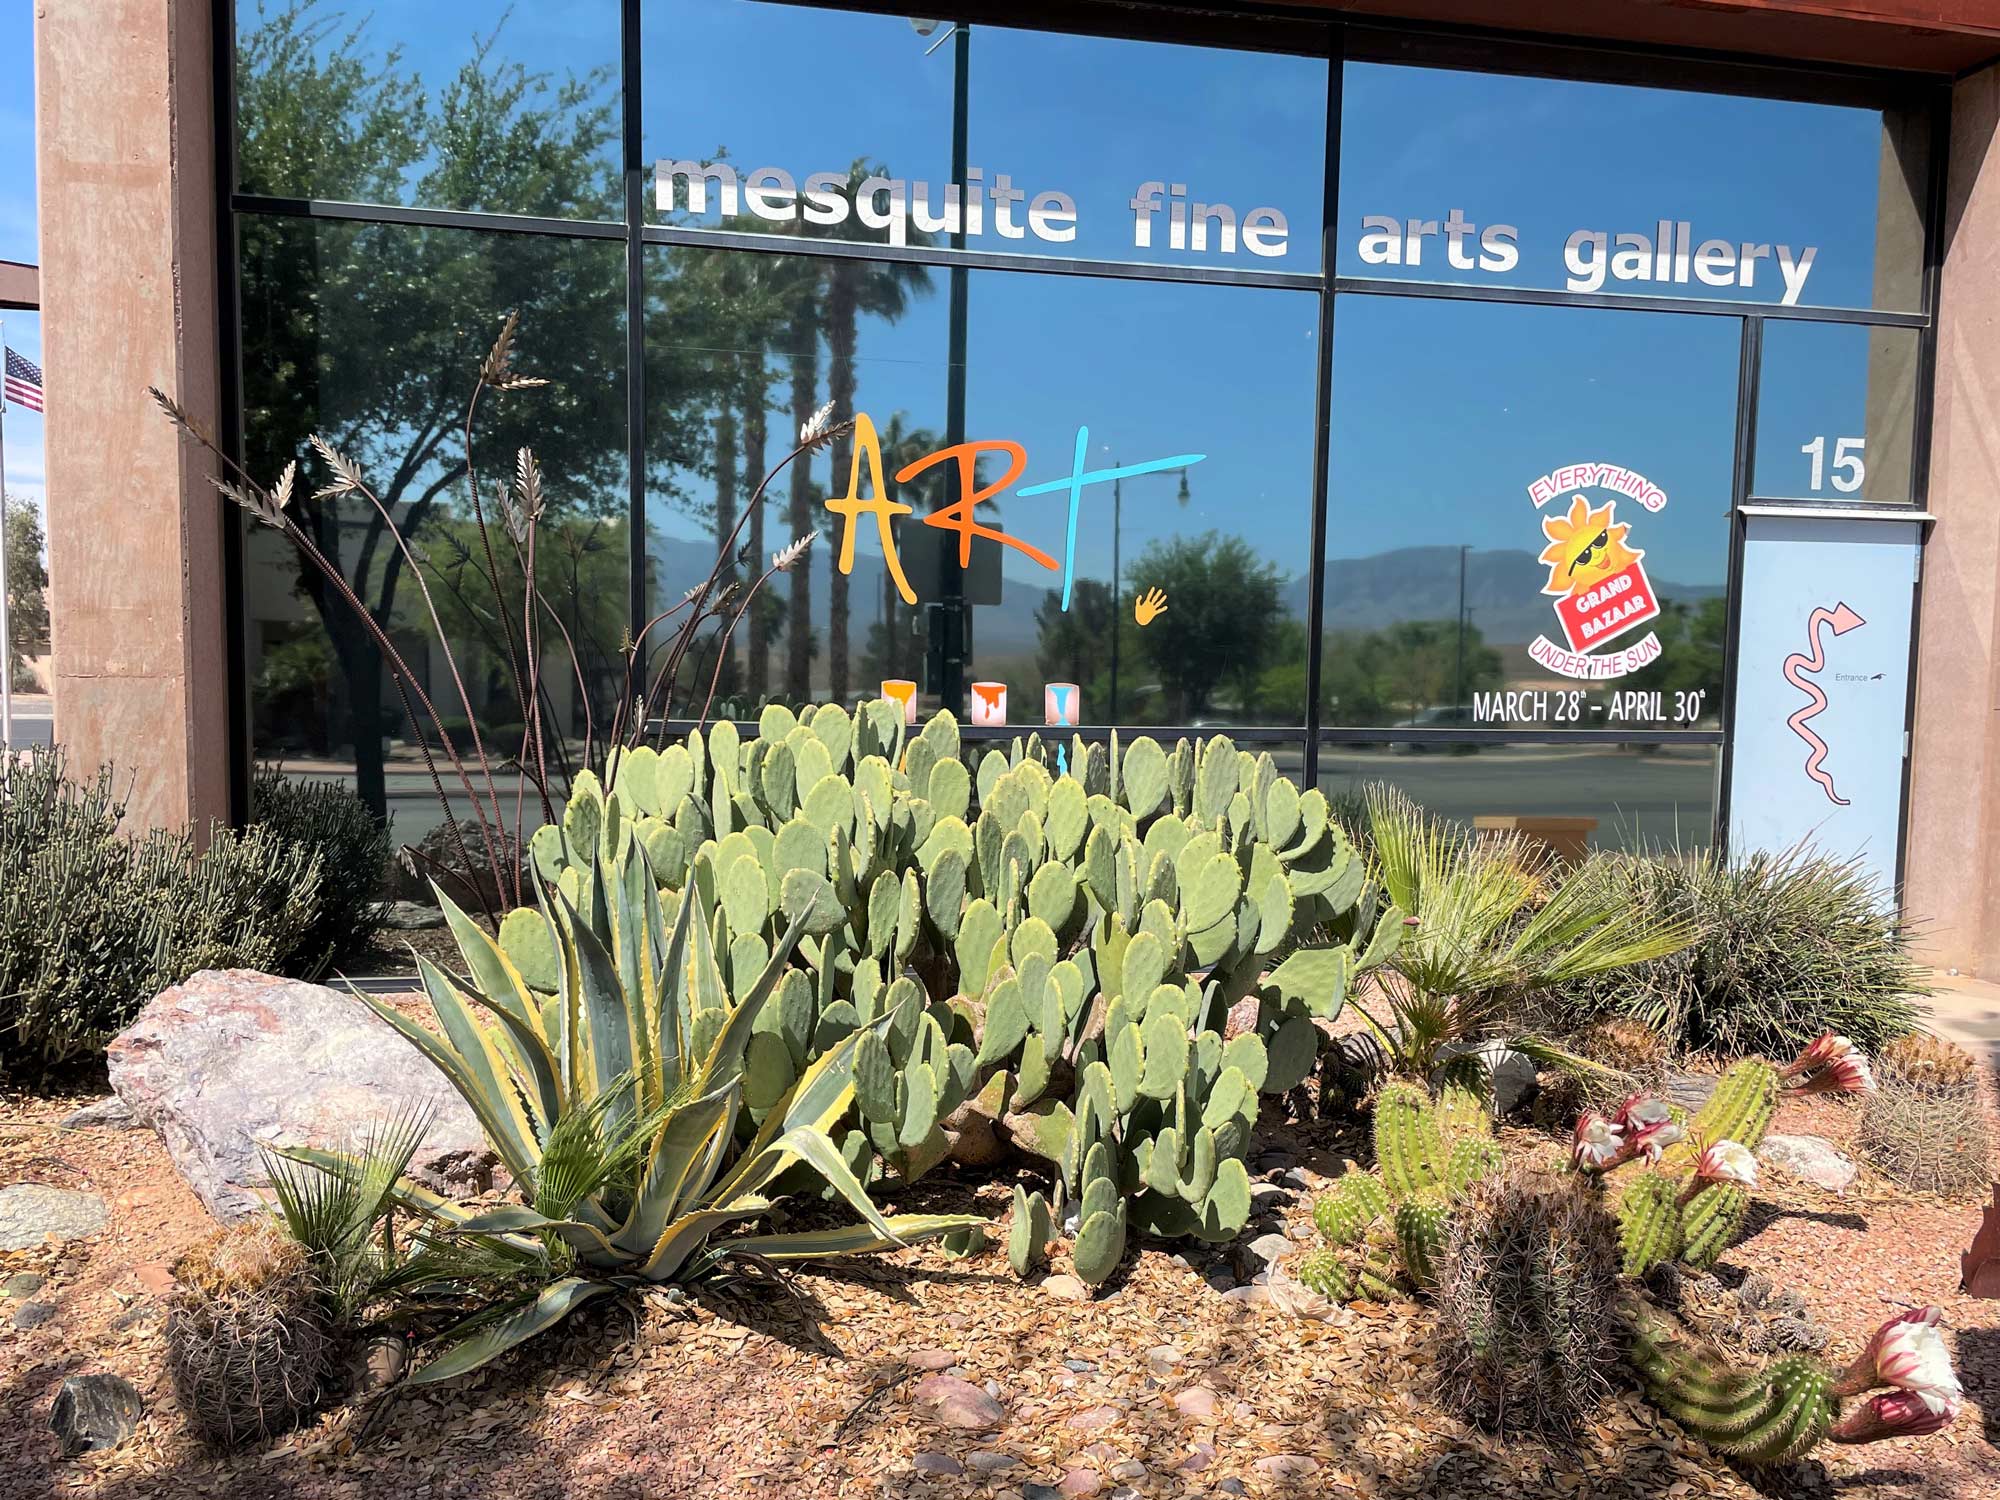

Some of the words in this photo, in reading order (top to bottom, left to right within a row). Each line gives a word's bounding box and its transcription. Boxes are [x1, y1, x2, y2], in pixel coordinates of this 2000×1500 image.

[656, 159, 1076, 246] mesquite
[1130, 182, 1288, 257] fine
[1358, 209, 1519, 272] arts
[1564, 220, 1818, 305] gallery
[1801, 436, 1866, 492] 15
[1530, 466, 1664, 510] EVERYTHING
[1575, 574, 1633, 614] GRAND
[1580, 595, 1647, 639] BAZAAR
[1531, 639, 1587, 676] UNDER
[1592, 658, 1623, 676] THE
[1626, 637, 1659, 669] SUN
[1835, 673, 1868, 682] Entrance
[1473, 691, 1547, 722] MARCH
[1608, 691, 1667, 721] APRIL
